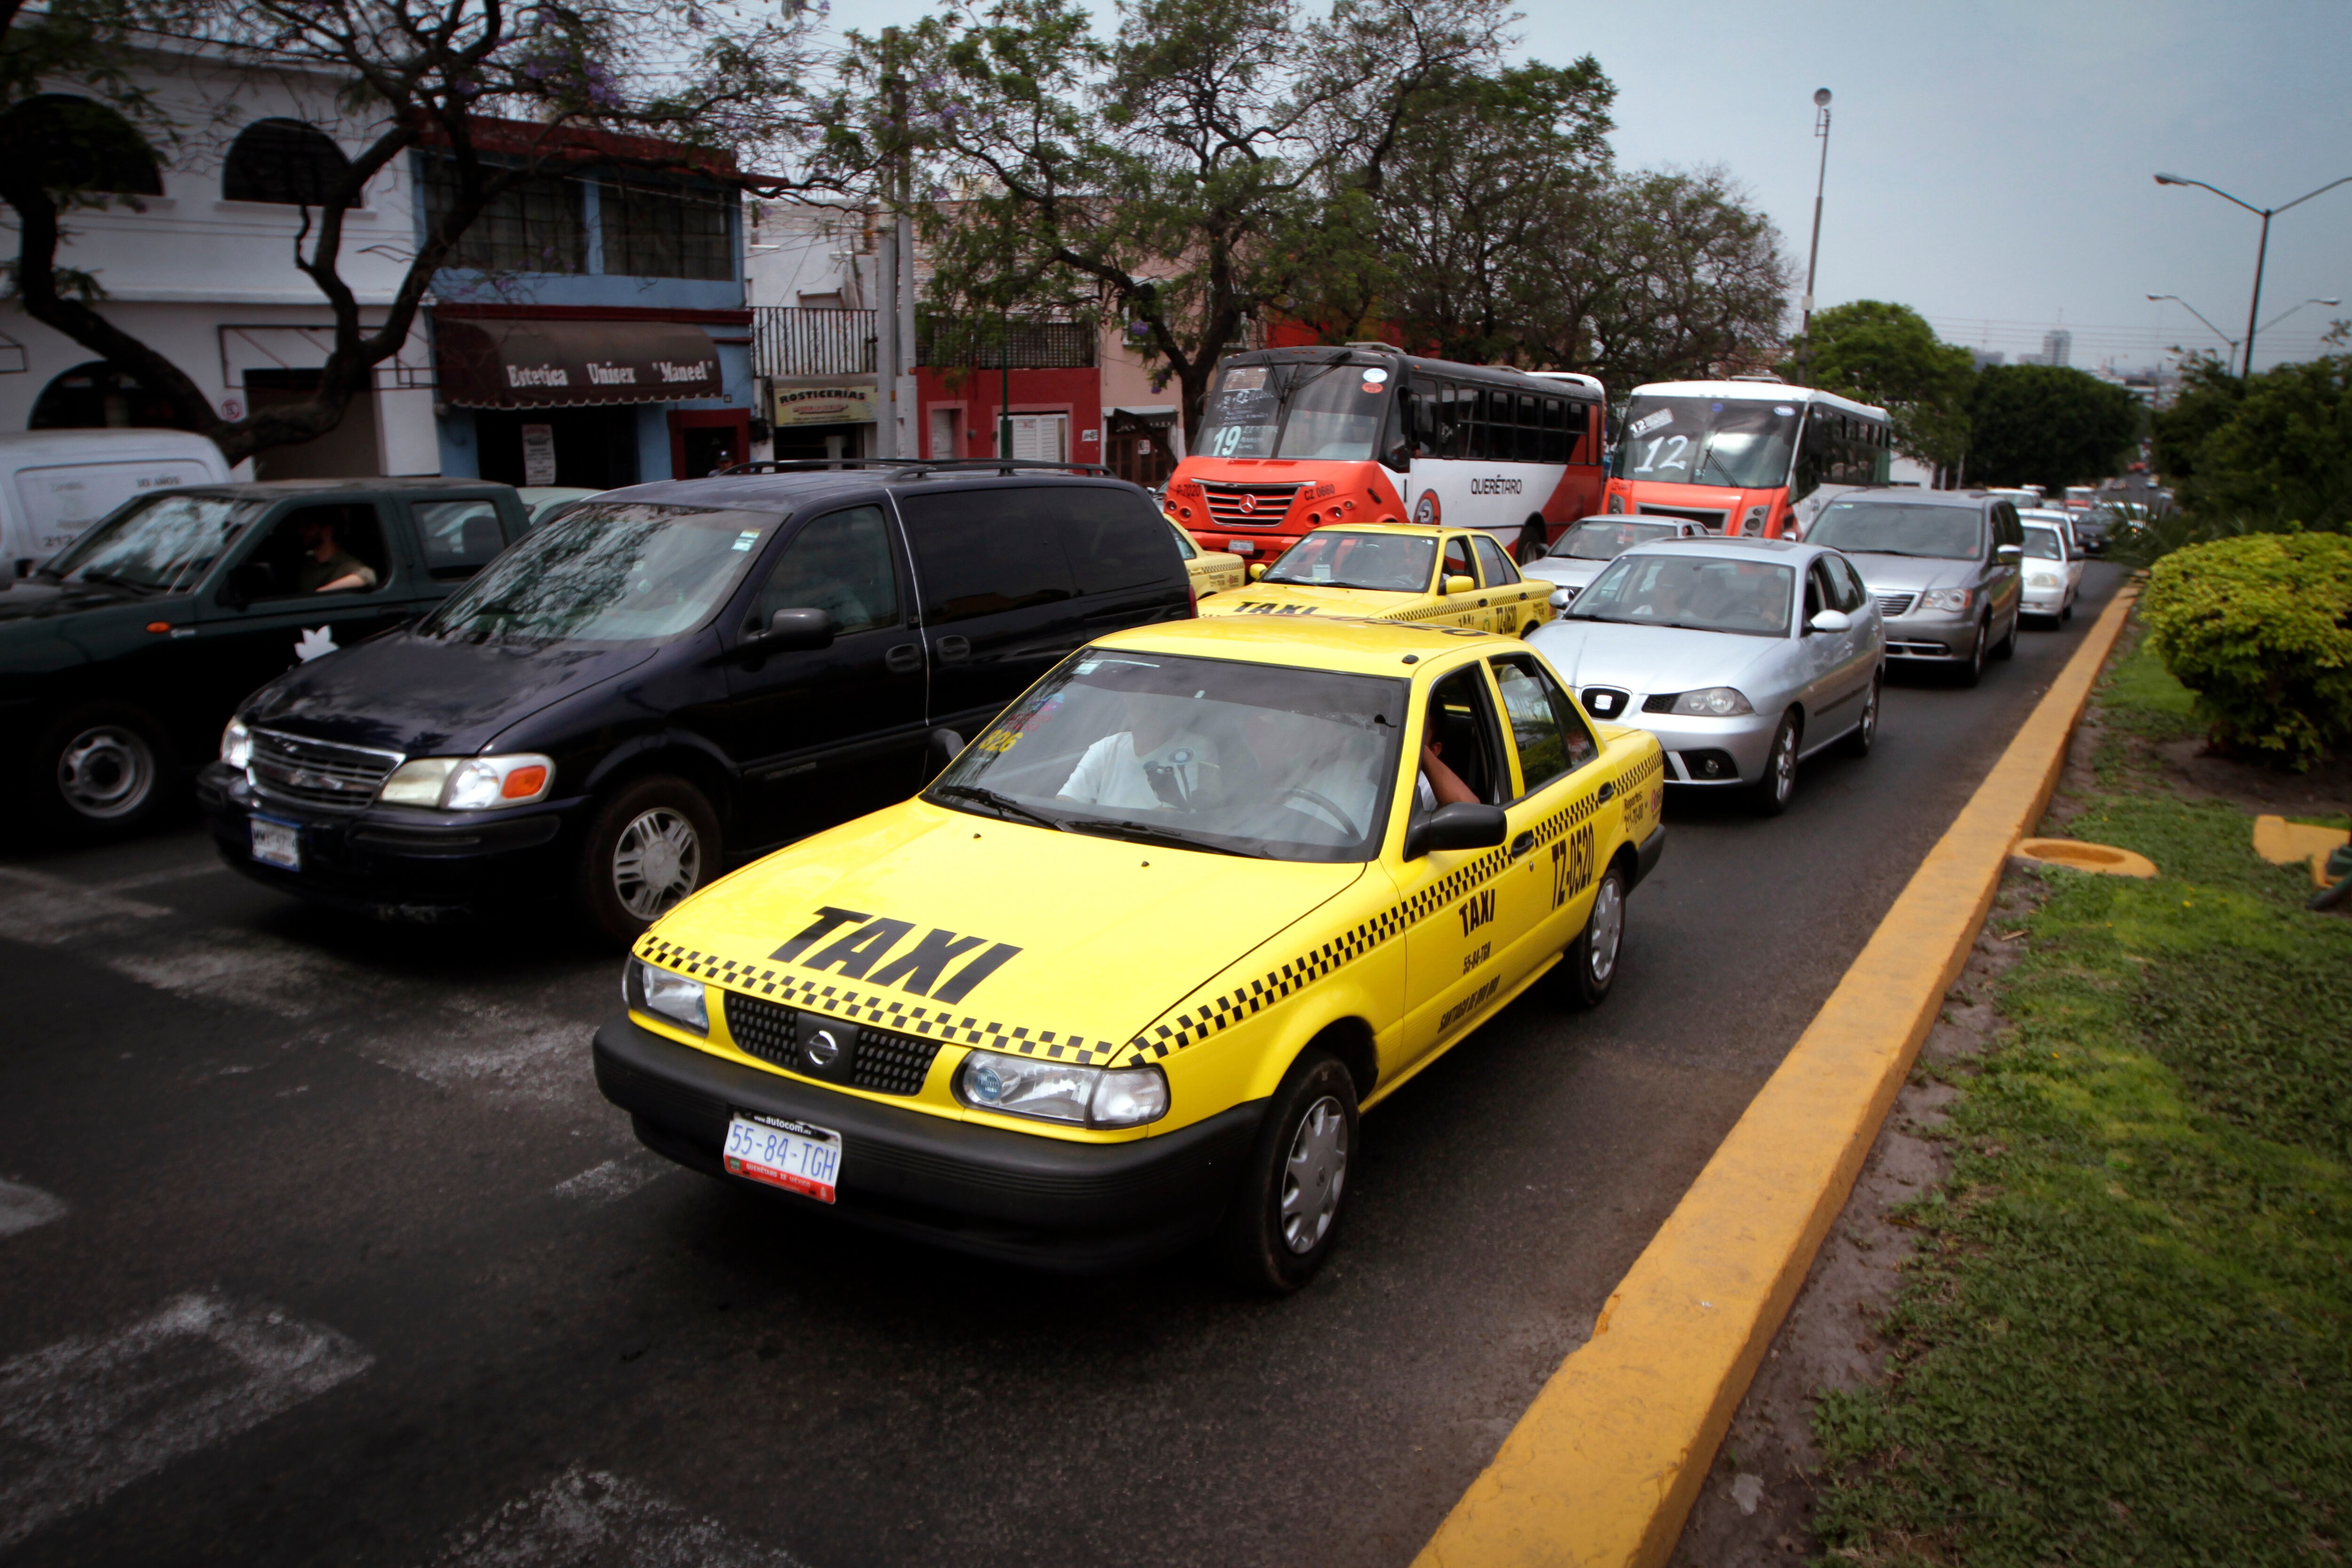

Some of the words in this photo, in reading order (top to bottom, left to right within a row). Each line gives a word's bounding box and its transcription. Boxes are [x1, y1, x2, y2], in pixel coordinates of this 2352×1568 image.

[587, 361, 636, 385] Unisex
[1630, 420, 1647, 433] 12
[1213, 426, 1242, 457] 19
[1634, 435, 1689, 474] 12
[1304, 488, 1315, 501] CZ
[1471, 474, 1523, 494] QUERÉTARO
[1233, 601, 1320, 614] TAXI
[1459, 614, 1475, 628] TAXI
[979, 729, 1024, 752] 826
[1552, 821, 1594, 911] TZ-0520
[1459, 888, 1495, 938] TAXI
[767, 906, 1025, 1005] TAXI
[730, 1123, 837, 1181] 55-84-TGH
[746, 1163, 778, 1178] QUERÉTARO
[789, 1176, 810, 1188] MÉXICO
